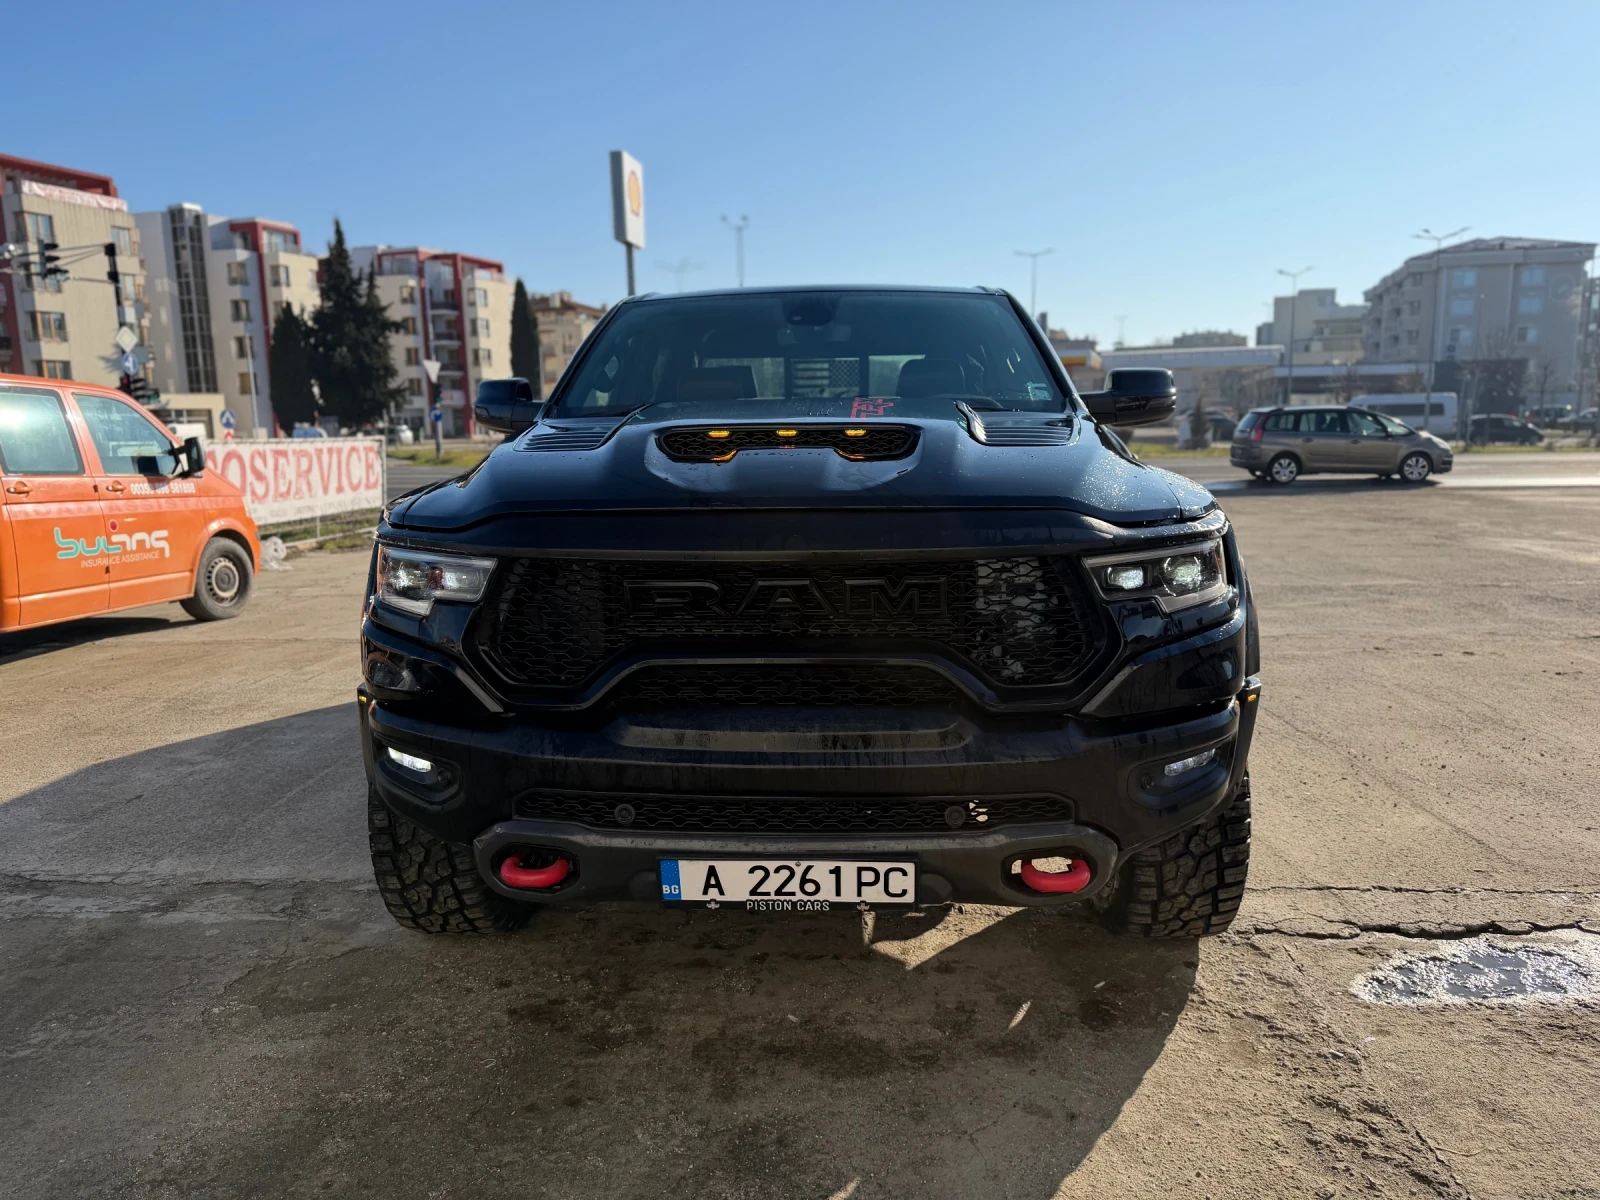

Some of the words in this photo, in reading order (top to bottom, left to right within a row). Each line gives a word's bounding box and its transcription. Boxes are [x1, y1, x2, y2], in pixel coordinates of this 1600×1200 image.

[81, 555, 121, 568] INSURANCE
[121, 550, 160, 564] ASSISTANCE
[623, 575, 948, 618] RAM
[662, 884, 680, 894] BG
[701, 865, 725, 896] A
[746, 901, 792, 911] PISTON
[796, 901, 830, 911] CARS
